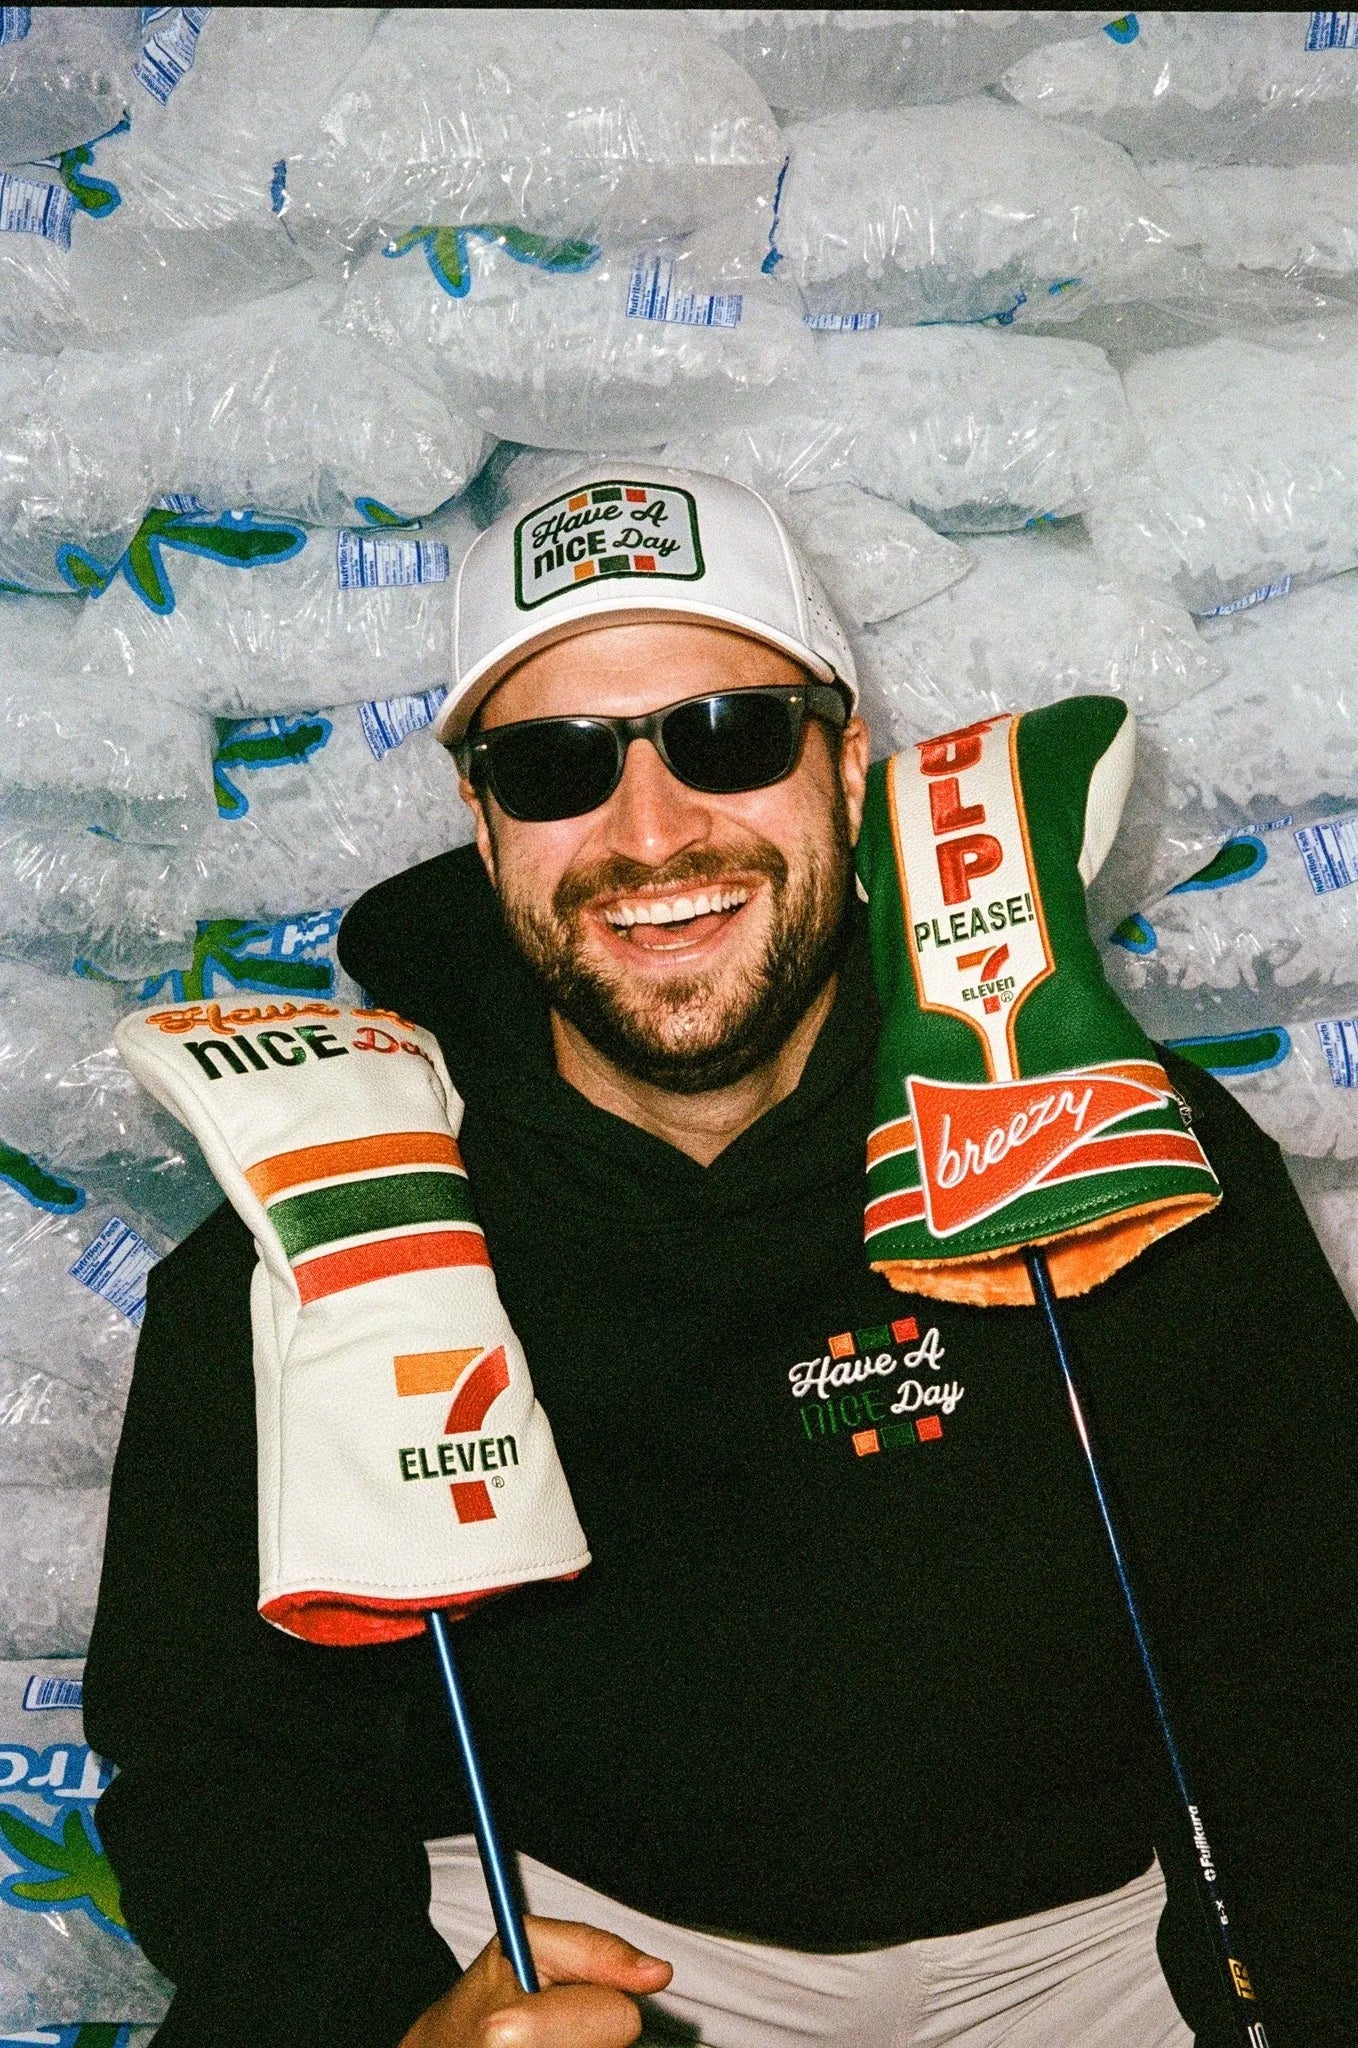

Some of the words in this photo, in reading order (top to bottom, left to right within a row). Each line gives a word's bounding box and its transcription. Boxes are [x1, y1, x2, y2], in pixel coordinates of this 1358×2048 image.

[629, 272, 643, 316] Nutrition
[532, 504, 623, 549] Have
[630, 500, 669, 528] A
[612, 527, 681, 557] Day
[1298, 831, 1311, 853] Facts
[1306, 852, 1325, 893] Nutrition
[914, 892, 1035, 952] PLEASE!
[937, 1088, 1093, 1189] breezy
[71, 1241, 103, 1276] Nutrition
[788, 1353, 897, 1399] Have
[903, 1327, 945, 1370] A
[890, 1380, 965, 1415] Day
[1188, 1804, 1215, 1868] Fujikura
